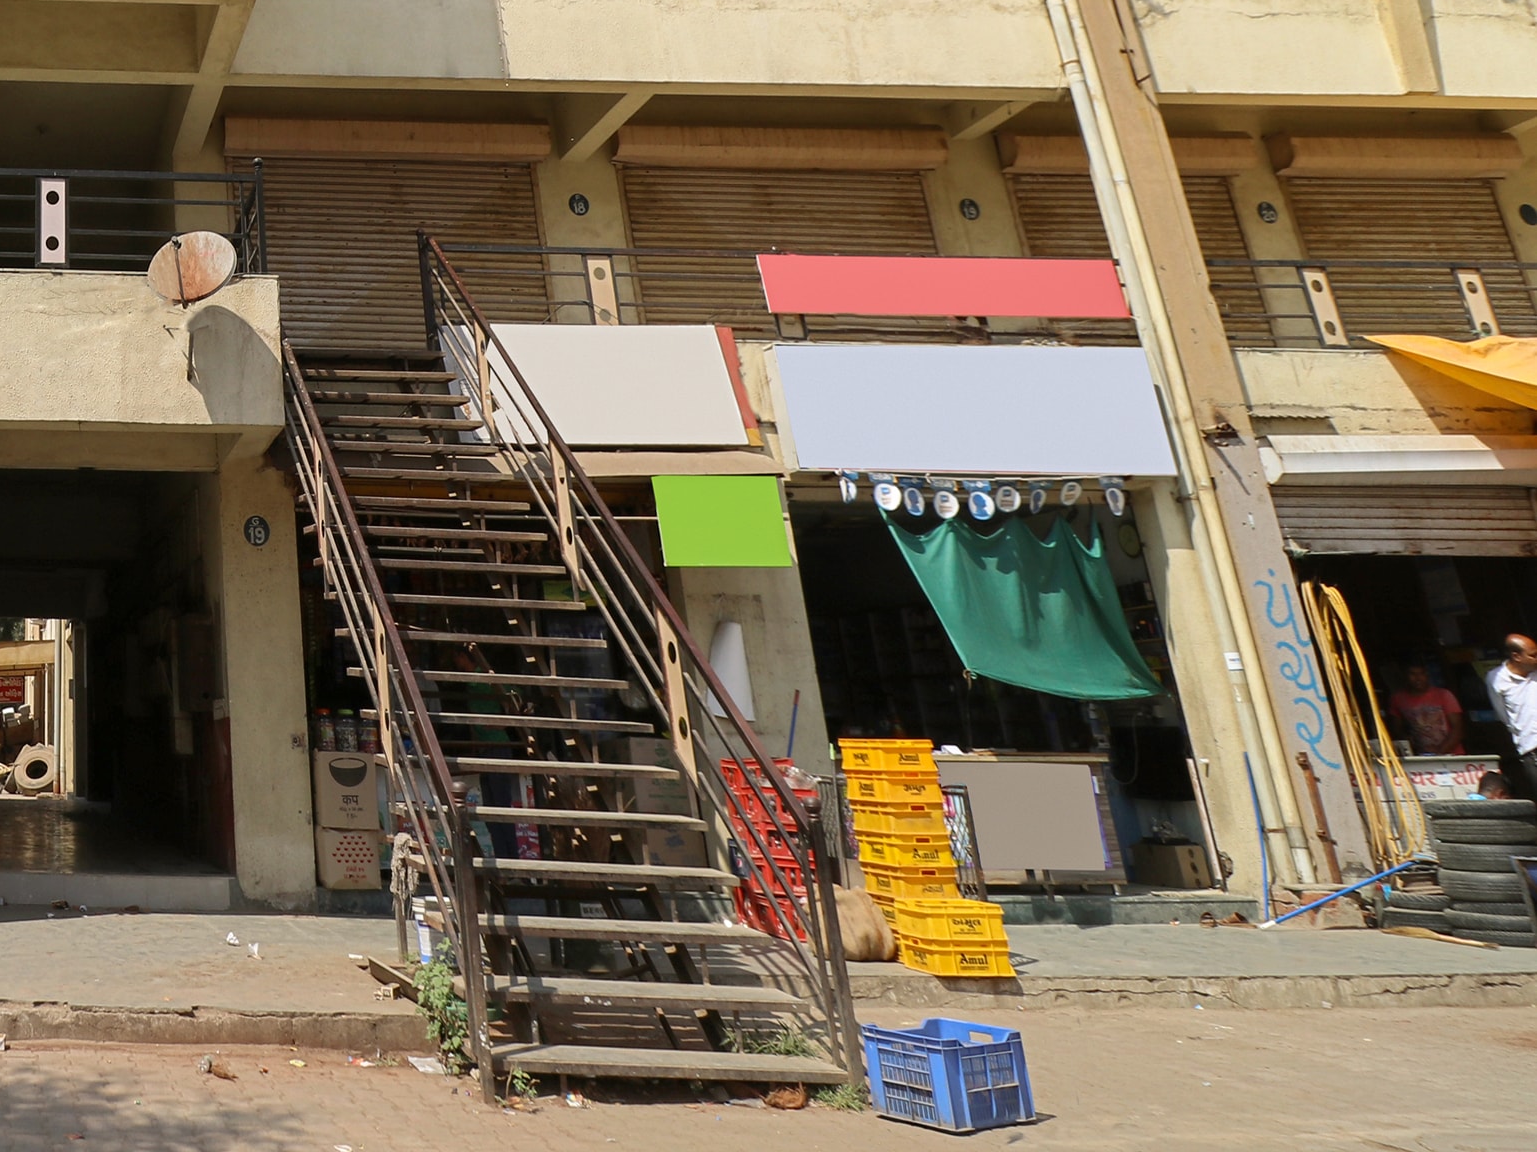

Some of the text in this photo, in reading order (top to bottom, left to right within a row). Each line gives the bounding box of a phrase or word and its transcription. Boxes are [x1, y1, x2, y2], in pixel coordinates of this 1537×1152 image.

[573, 202, 586, 214] 18
[249, 528, 265, 544] 19
[341, 794, 359, 806] कप
[913, 848, 940, 861] Amul
[960, 953, 988, 965] Amul
